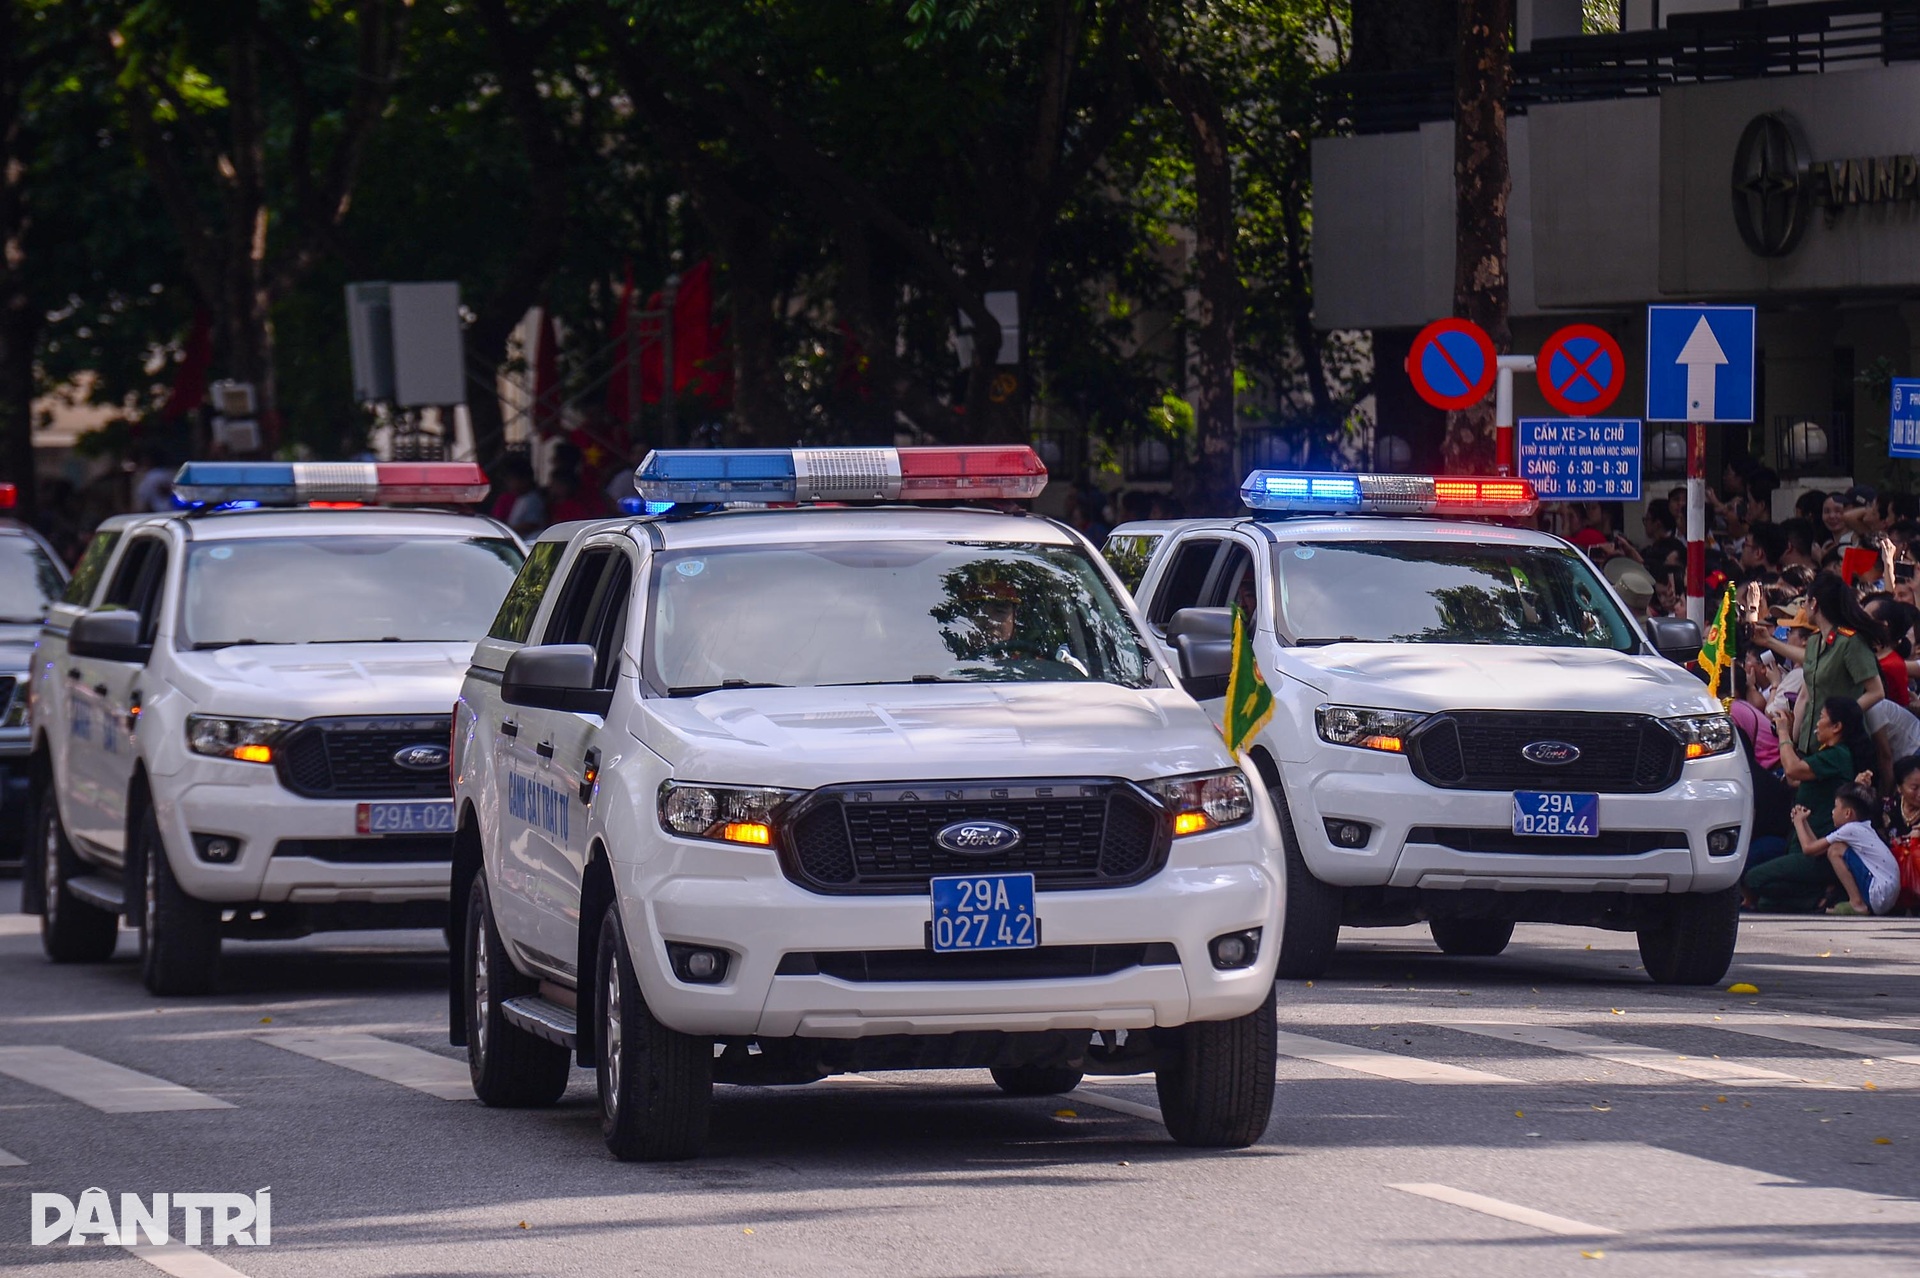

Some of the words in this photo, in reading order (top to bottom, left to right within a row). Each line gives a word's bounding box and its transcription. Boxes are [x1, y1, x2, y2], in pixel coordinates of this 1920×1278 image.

[1562, 426, 1576, 441] XE
[1589, 426, 1600, 441] 16
[1539, 445, 1548, 456] XE
[1569, 445, 1577, 456] XE
[408, 748, 443, 764] Ford
[1535, 744, 1568, 759] Ford
[854, 786, 1100, 802] RANGER
[1538, 794, 1574, 813] 29A
[373, 805, 456, 830] 29A-02
[1523, 814, 1589, 834] 028.44
[956, 826, 1003, 847] Ford
[956, 879, 1010, 913] 29A
[936, 913, 1033, 948] 027.42
